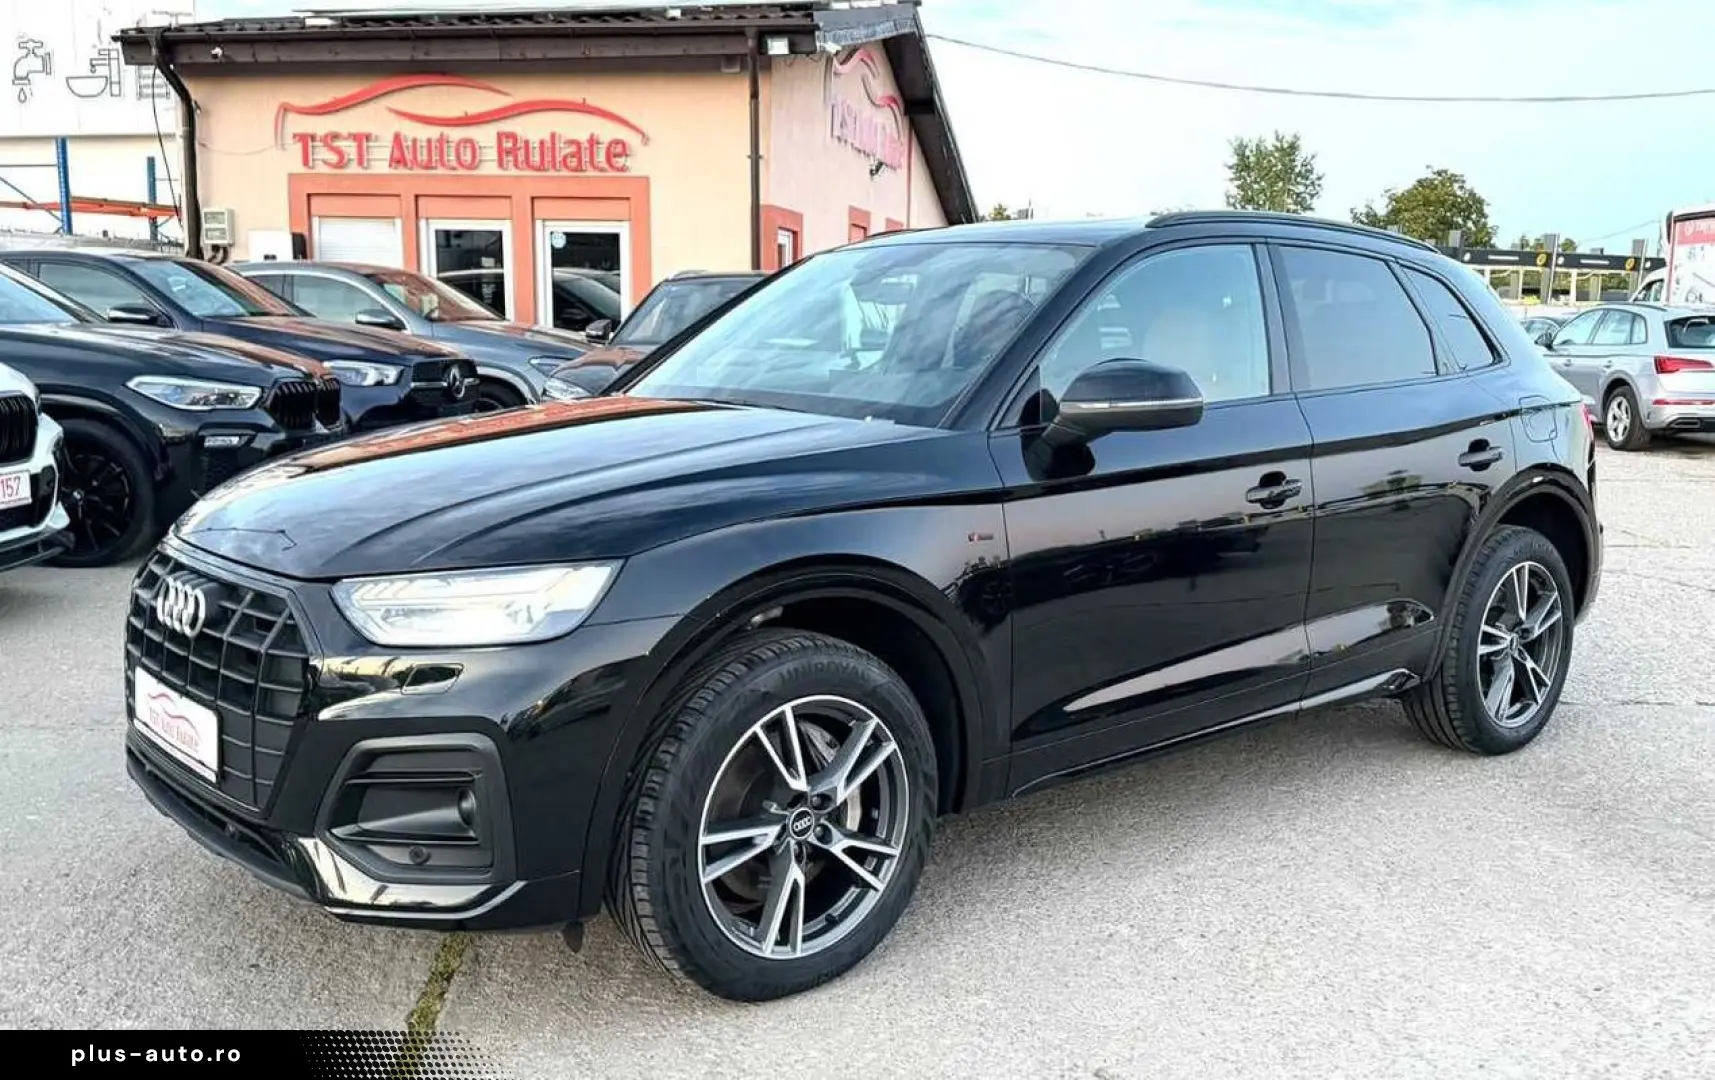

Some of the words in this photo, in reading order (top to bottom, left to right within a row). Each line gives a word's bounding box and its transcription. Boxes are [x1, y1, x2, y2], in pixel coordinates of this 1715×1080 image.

[293, 131, 371, 169] TST
[388, 131, 478, 171] Auto
[496, 131, 630, 172] Rulate
